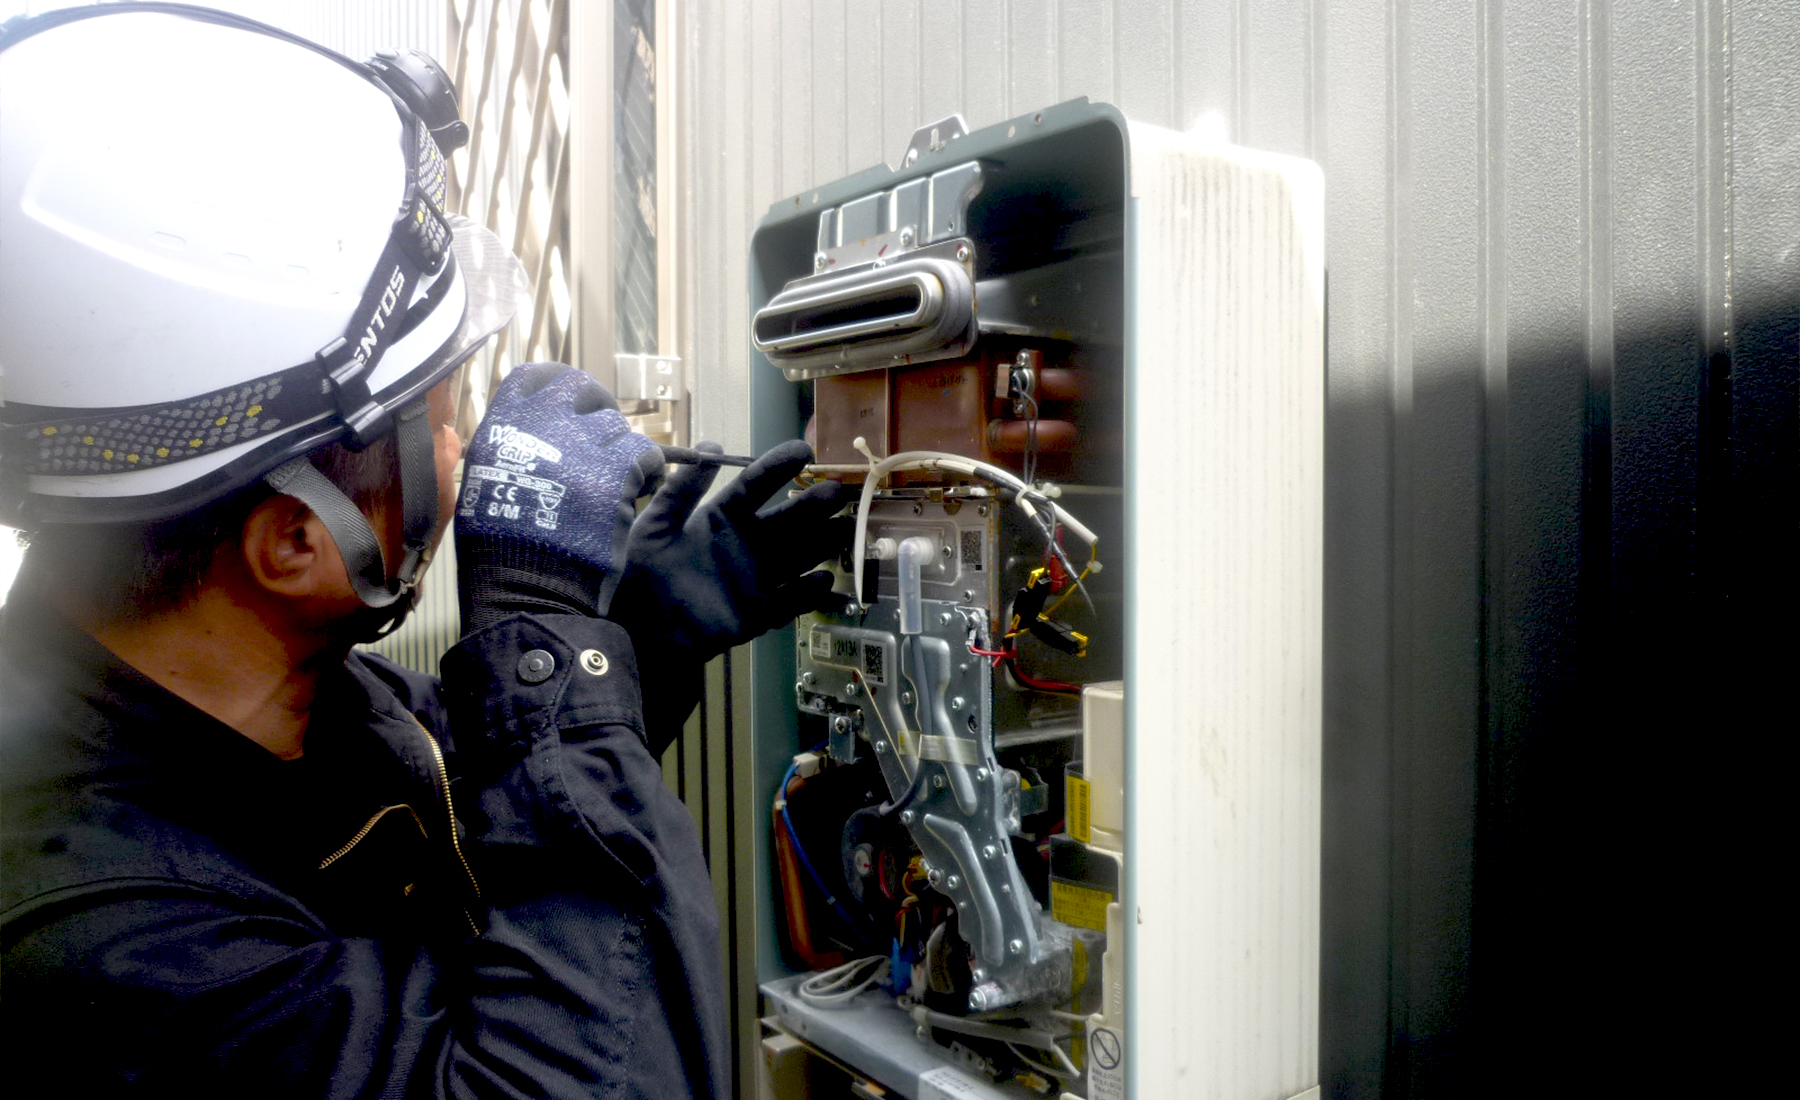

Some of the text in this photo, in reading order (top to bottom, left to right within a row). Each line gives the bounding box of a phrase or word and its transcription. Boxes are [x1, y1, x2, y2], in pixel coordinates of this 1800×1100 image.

[488, 425, 562, 463] WONDER
[497, 445, 534, 463] GRIP
[517, 476, 552, 490] WG-300
[488, 502, 520, 520] 8/M
